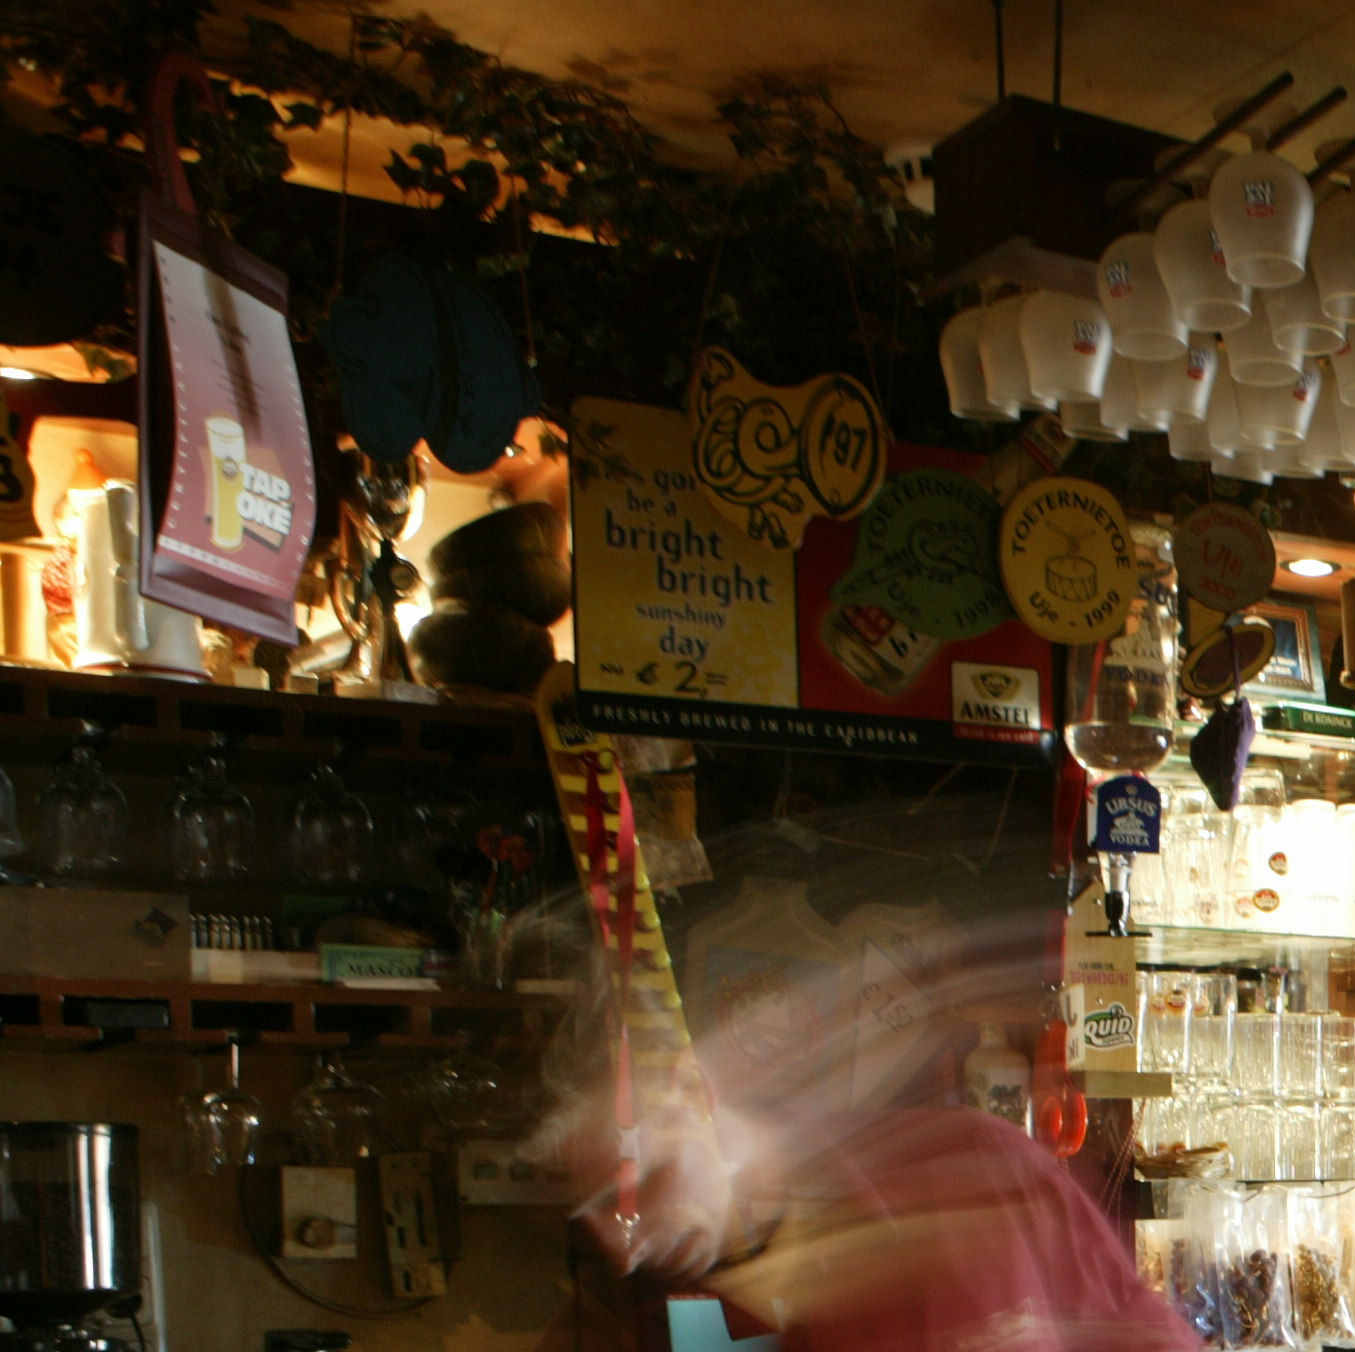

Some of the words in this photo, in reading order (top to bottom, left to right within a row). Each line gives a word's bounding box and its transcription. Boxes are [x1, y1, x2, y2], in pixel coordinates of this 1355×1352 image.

[240, 463, 293, 503] TAP
[626, 487, 655, 513] be
[664, 502, 678, 518] a
[604, 509, 725, 565] bright
[1010, 488, 1132, 572] TOETERNIETOE
[656, 555, 775, 607] bright
[634, 602, 726, 630] sunshiny
[1028, 589, 1061, 625] Uje
[1083, 589, 1121, 629] 1999
[658, 623, 709, 664] day
[635, 660, 660, 686] €
[592, 703, 673, 727] FRESHLY
[679, 710, 752, 734] BREWED
[759, 717, 781, 736] IN
[785, 718, 818, 739] THE
[823, 723, 920, 750] CARIBBEAN
[959, 700, 1031, 726] AMSTEL
[1105, 796, 1157, 819] URSUS
[1110, 831, 1150, 847] VODKA
